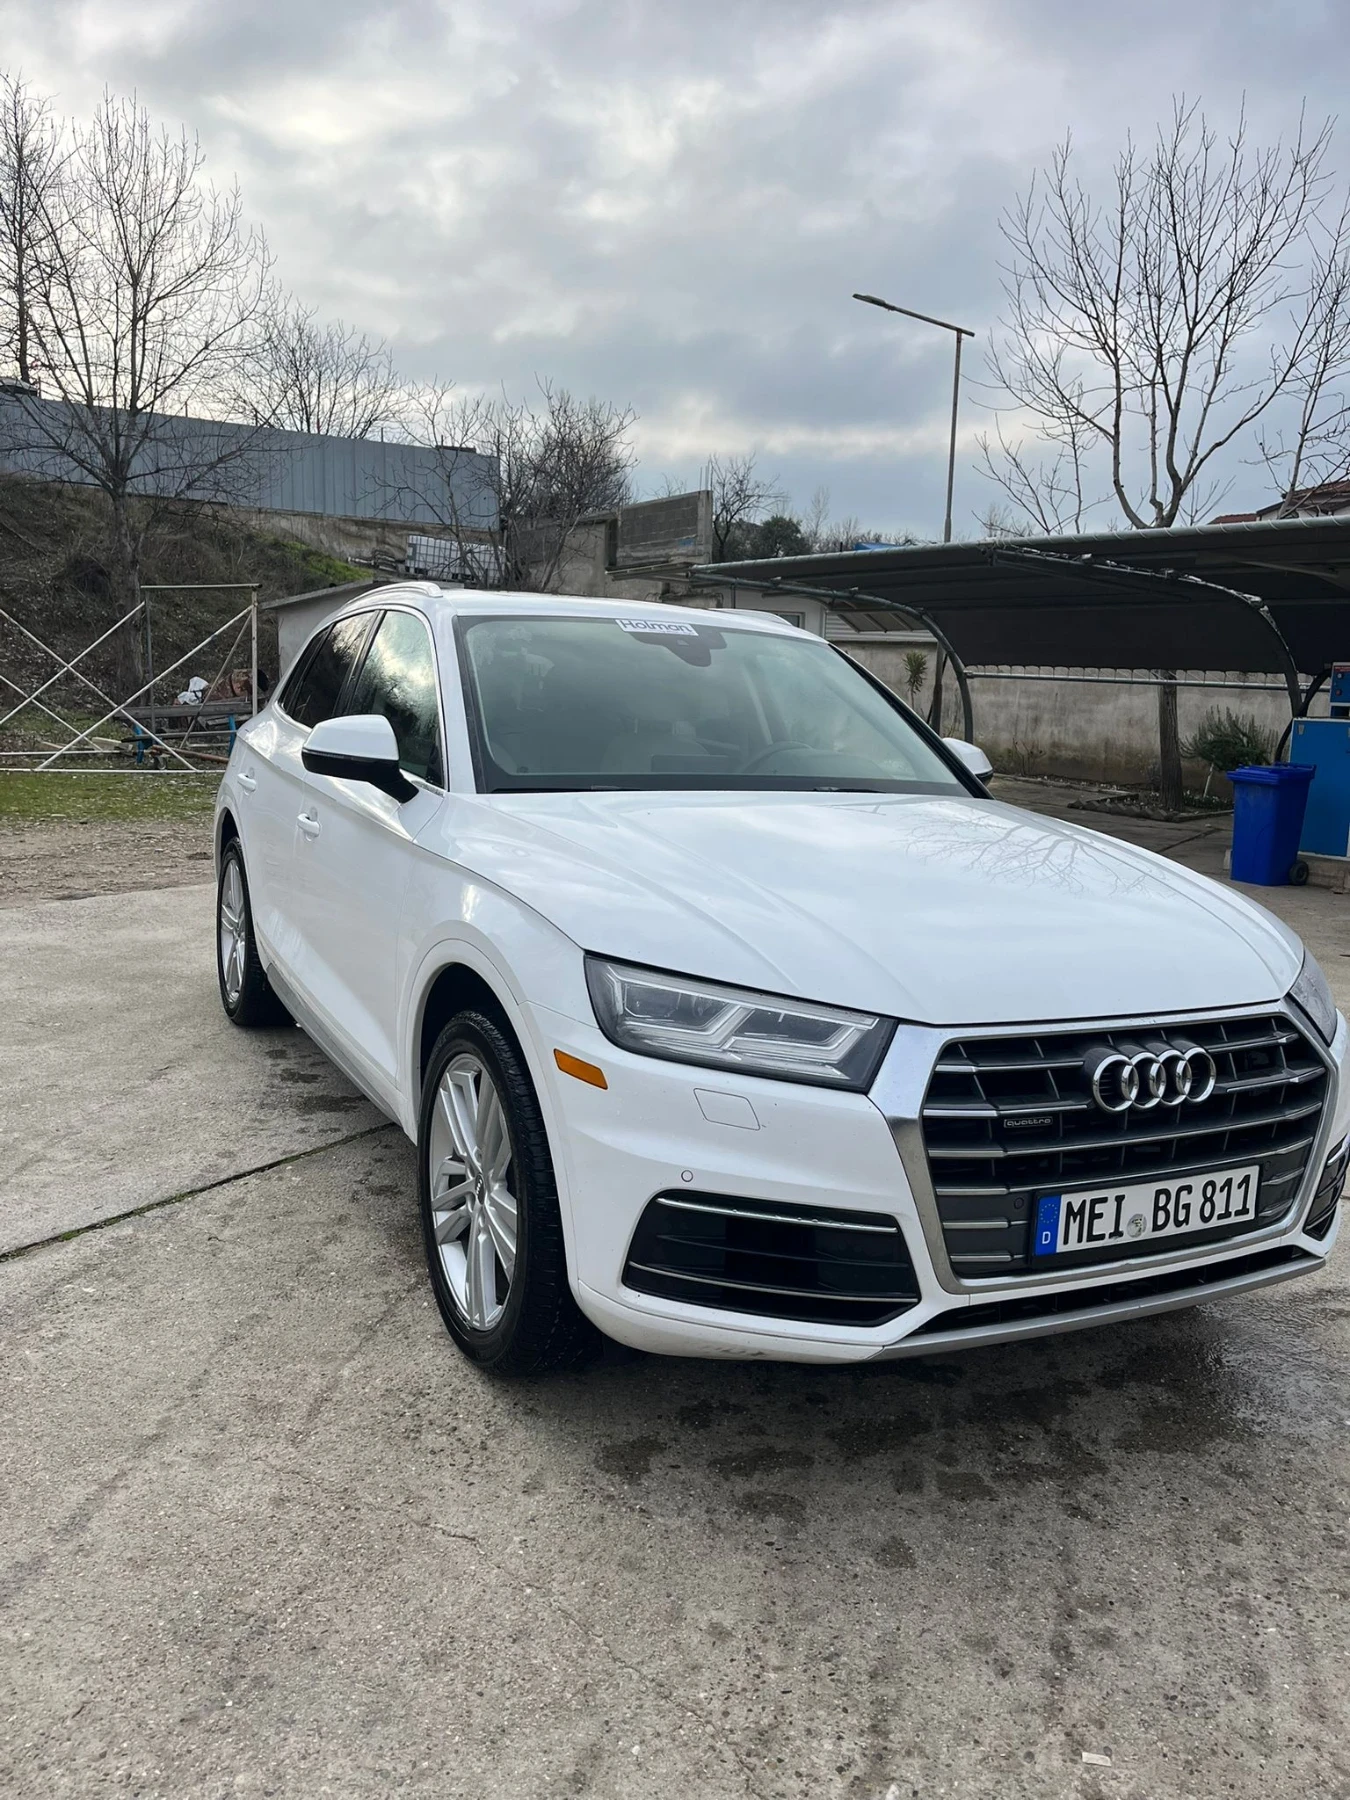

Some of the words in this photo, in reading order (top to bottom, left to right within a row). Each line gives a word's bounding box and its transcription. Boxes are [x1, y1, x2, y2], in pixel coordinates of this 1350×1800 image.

[620, 620, 692, 632] Holman
[1006, 1118, 1051, 1127] quattro
[1063, 1194, 1126, 1245] MEI
[1152, 1184, 1193, 1232] BG
[1199, 1174, 1251, 1223] 811
[1042, 1231, 1051, 1244] D
